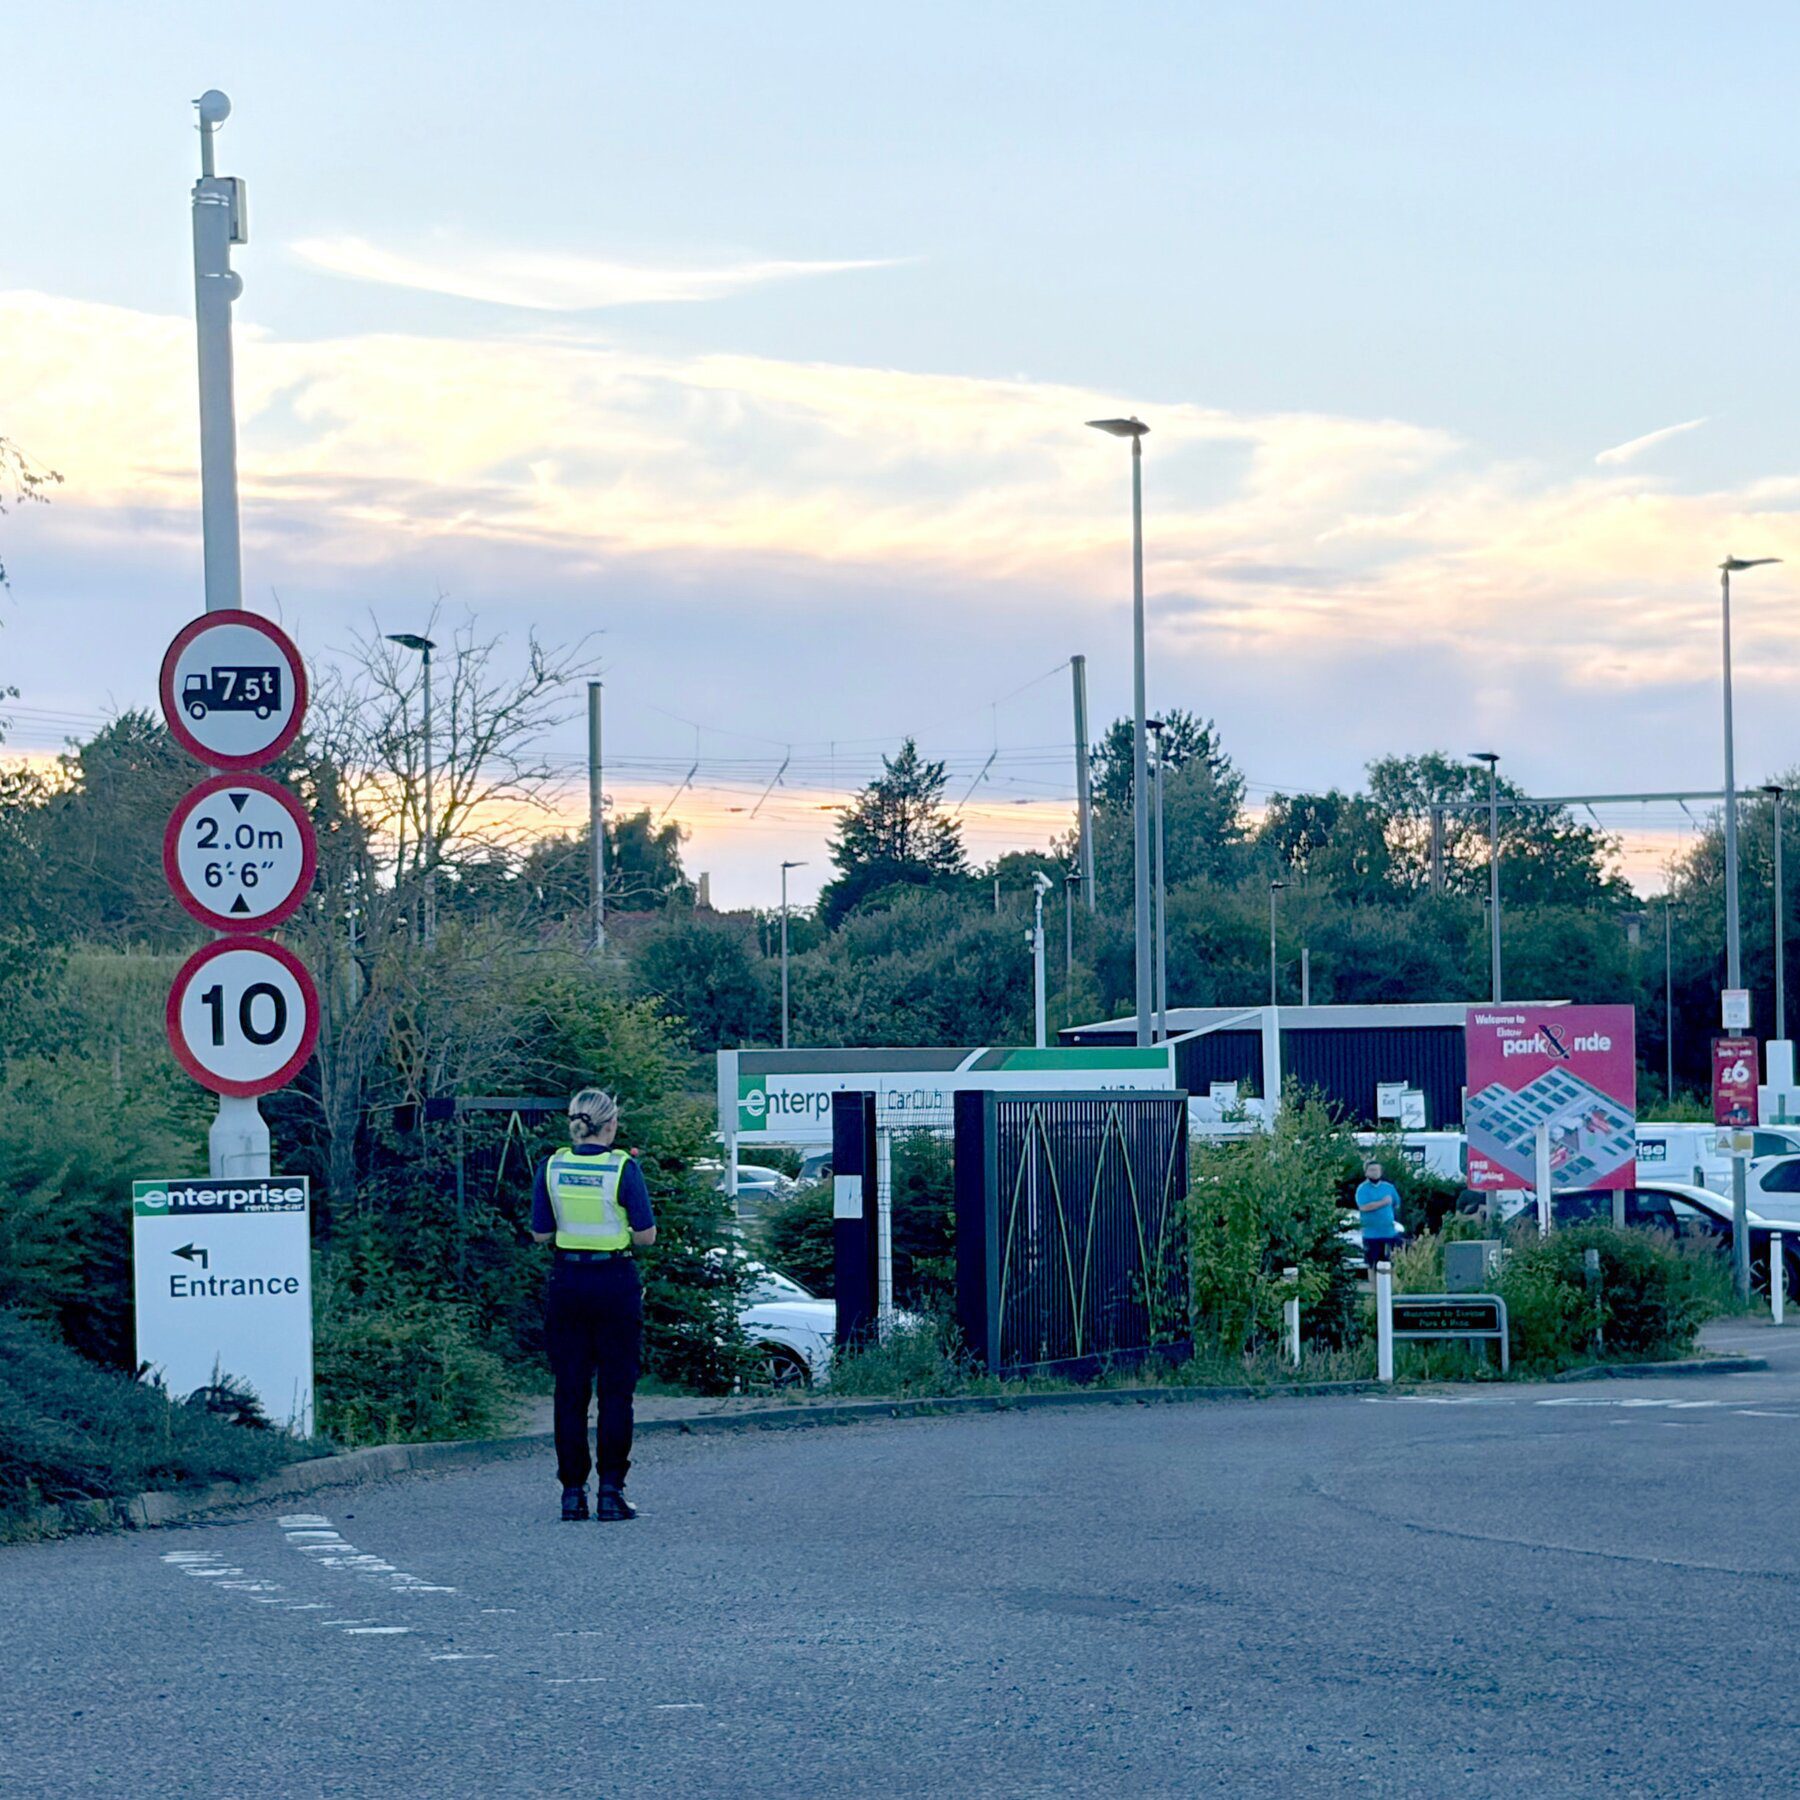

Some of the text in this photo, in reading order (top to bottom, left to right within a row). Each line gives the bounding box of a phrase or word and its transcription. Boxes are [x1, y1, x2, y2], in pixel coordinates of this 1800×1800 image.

[217, 671, 274, 701] 7.5t
[195, 817, 283, 850] 2.0m
[202, 982, 287, 1046] 10
[1475, 1014, 1526, 1024] Welcome to
[1503, 1033, 1548, 1057] park
[1573, 1030, 1612, 1051] ride
[141, 1183, 304, 1210] enterprise
[244, 1202, 304, 1213] rent-a-car
[170, 1275, 299, 1298] Entrance
